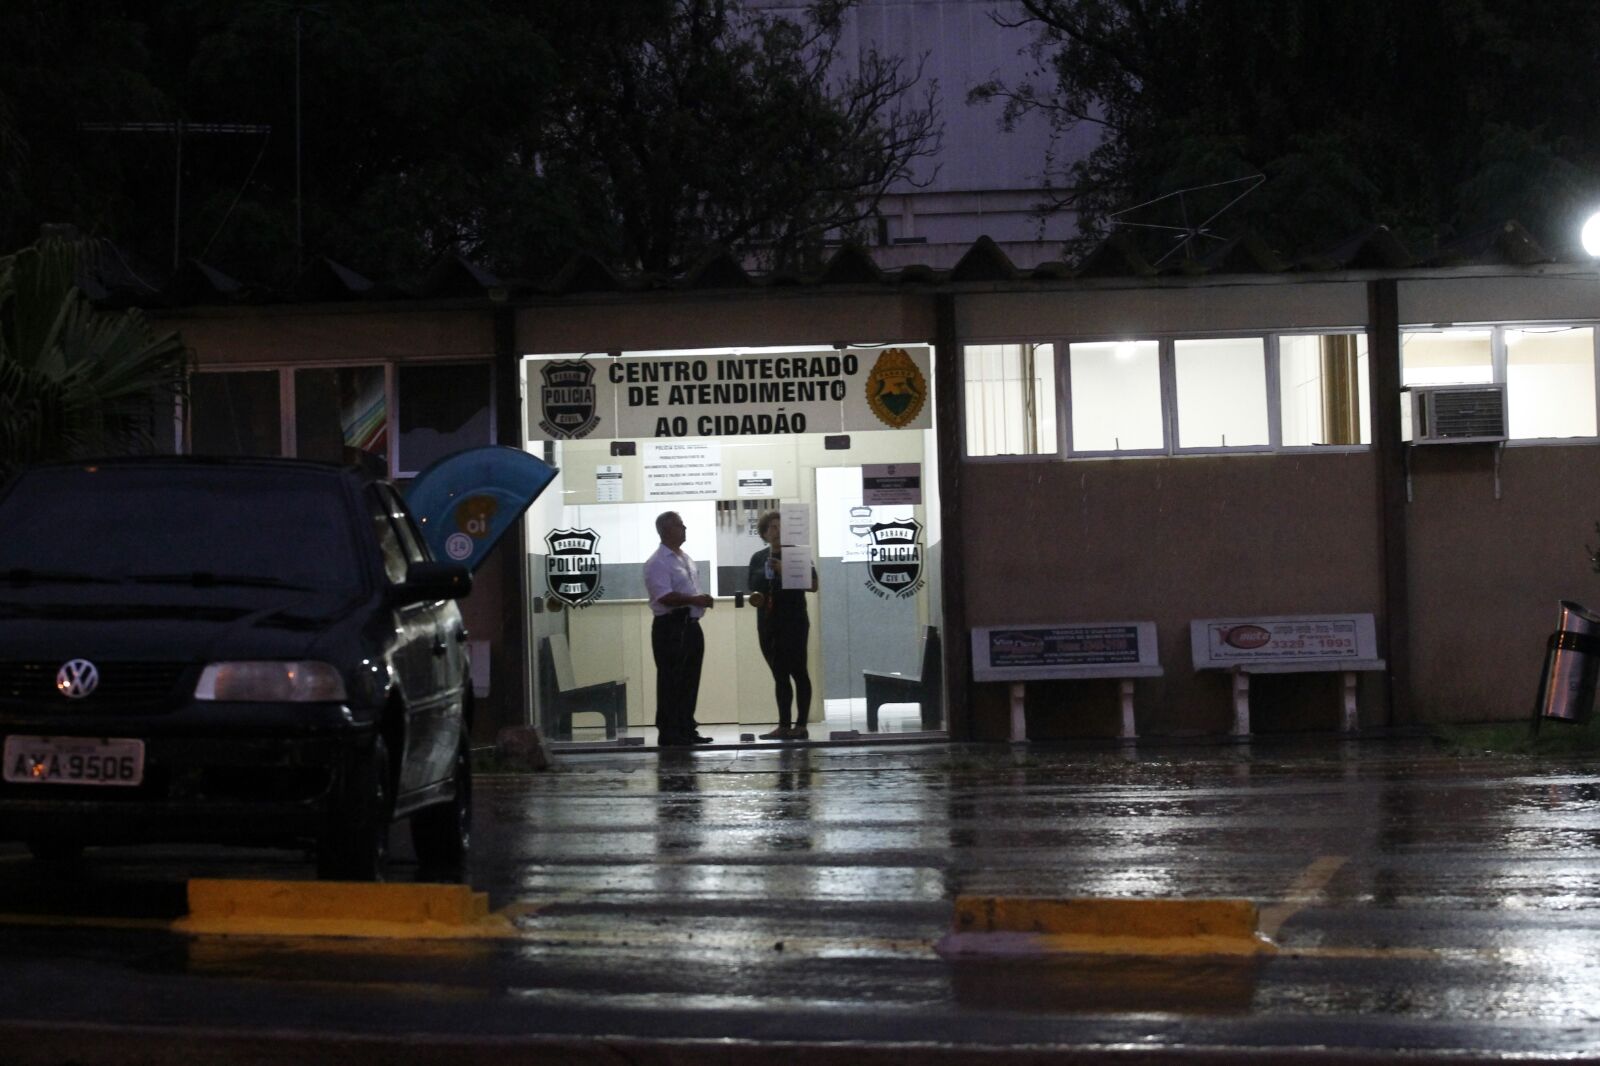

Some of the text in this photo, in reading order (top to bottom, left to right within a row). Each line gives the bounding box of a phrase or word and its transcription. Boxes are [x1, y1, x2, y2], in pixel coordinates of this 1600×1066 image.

[608, 354, 859, 384] CENTRO INTEGRADO
[628, 378, 846, 407] DE ATENDIMENTO
[655, 406, 806, 438] AO CIDADÃO
[467, 514, 486, 534] oi
[68, 755, 134, 780] 9506
